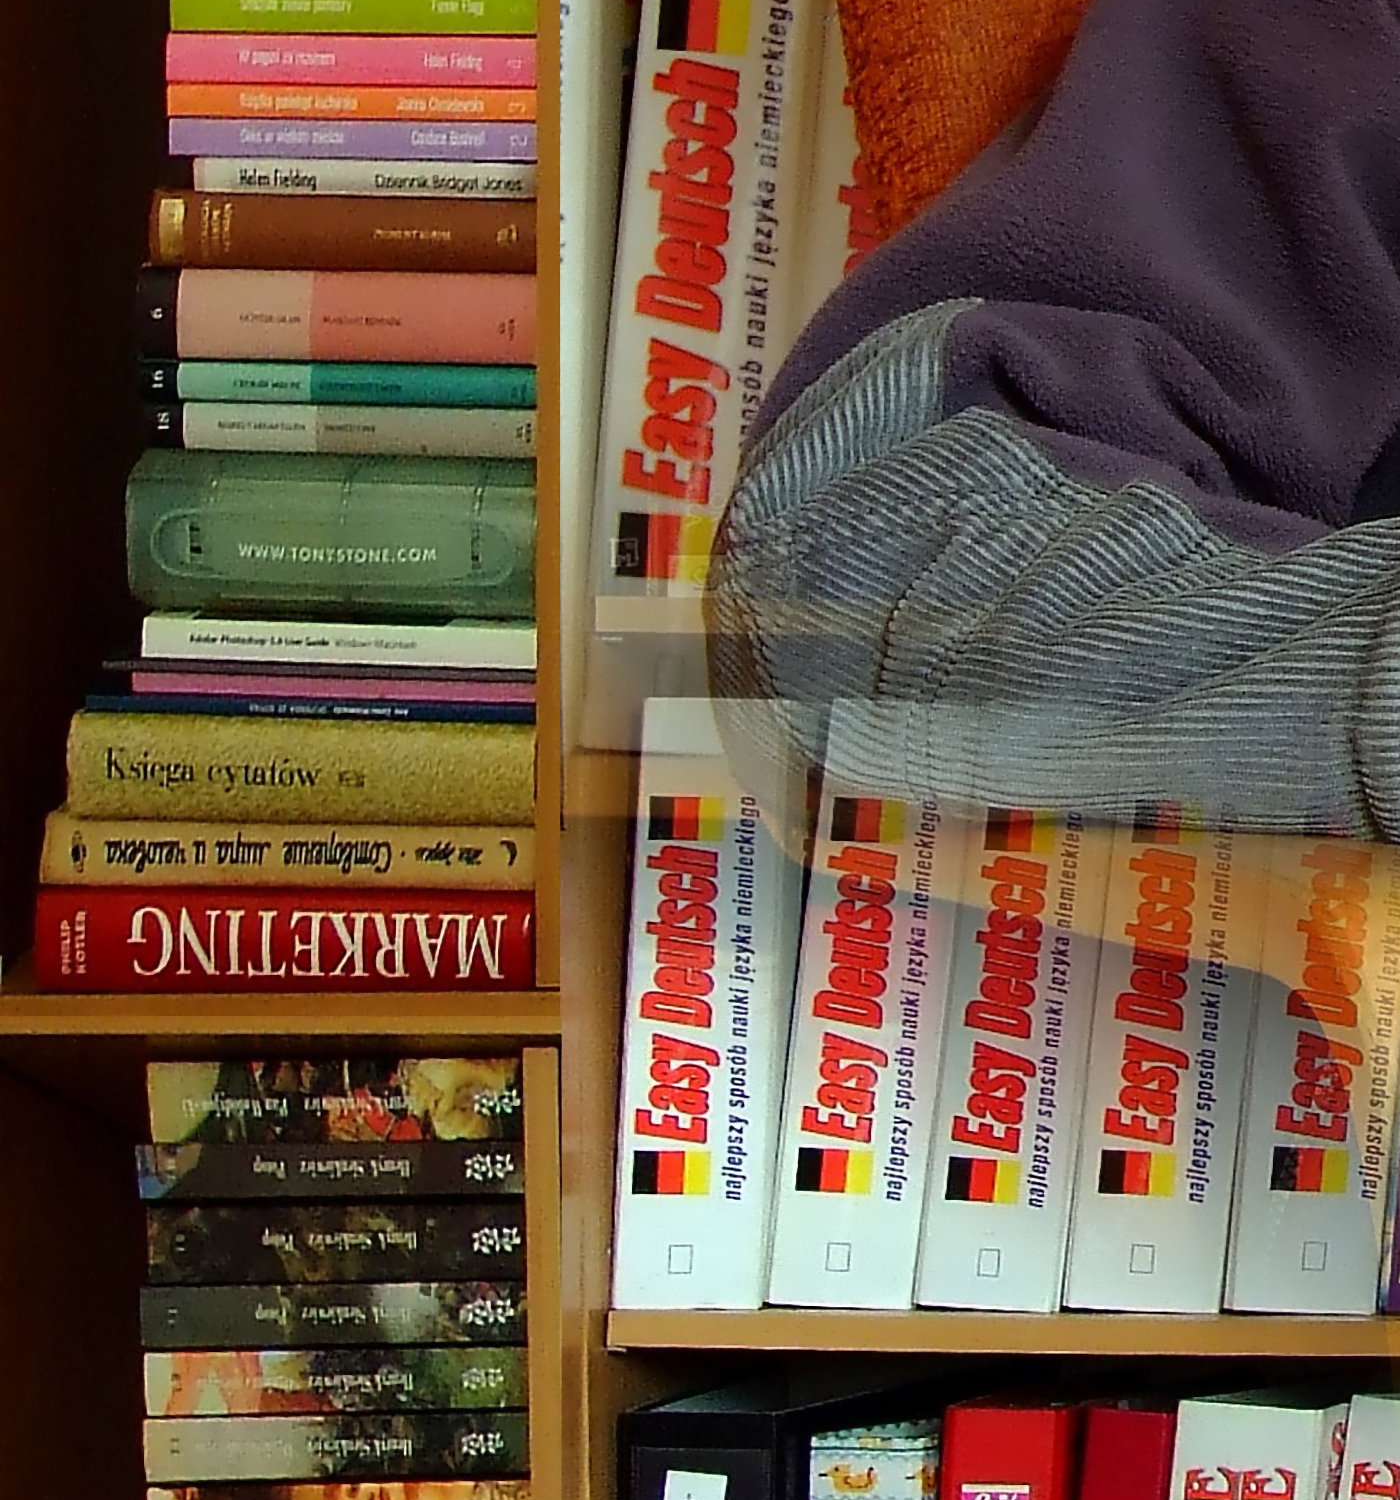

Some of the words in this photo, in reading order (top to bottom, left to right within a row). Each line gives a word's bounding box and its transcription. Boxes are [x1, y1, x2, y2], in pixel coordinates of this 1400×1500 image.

[238, 168, 269, 187] Helen
[274, 167, 317, 191] Fielding
[636, 57, 740, 333] Deutsch
[622, 338, 730, 506] Easy
[105, 747, 195, 785] Księga
[207, 753, 319, 793] cytatów
[736, 796, 757, 917] niemieckiego
[127, 906, 505, 980] MARKETING
[640, 844, 721, 1029] Deutsch
[735, 920, 754, 980] języka
[814, 844, 900, 1029] Deutsch
[965, 853, 1050, 1040] Deutsch
[1116, 844, 1199, 1033] Deutsch
[1287, 844, 1375, 1026] Deutsch
[733, 985, 751, 1040] nauki
[635, 1033, 719, 1145] Easy
[729, 1047, 749, 1108] sposób
[802, 1036, 889, 1145] Easy
[951, 1040, 1036, 1154] Easy
[1104, 1033, 1188, 1145] Easy
[1275, 1026, 1364, 1144] Easy
[724, 1114, 749, 1201] najlepszy
